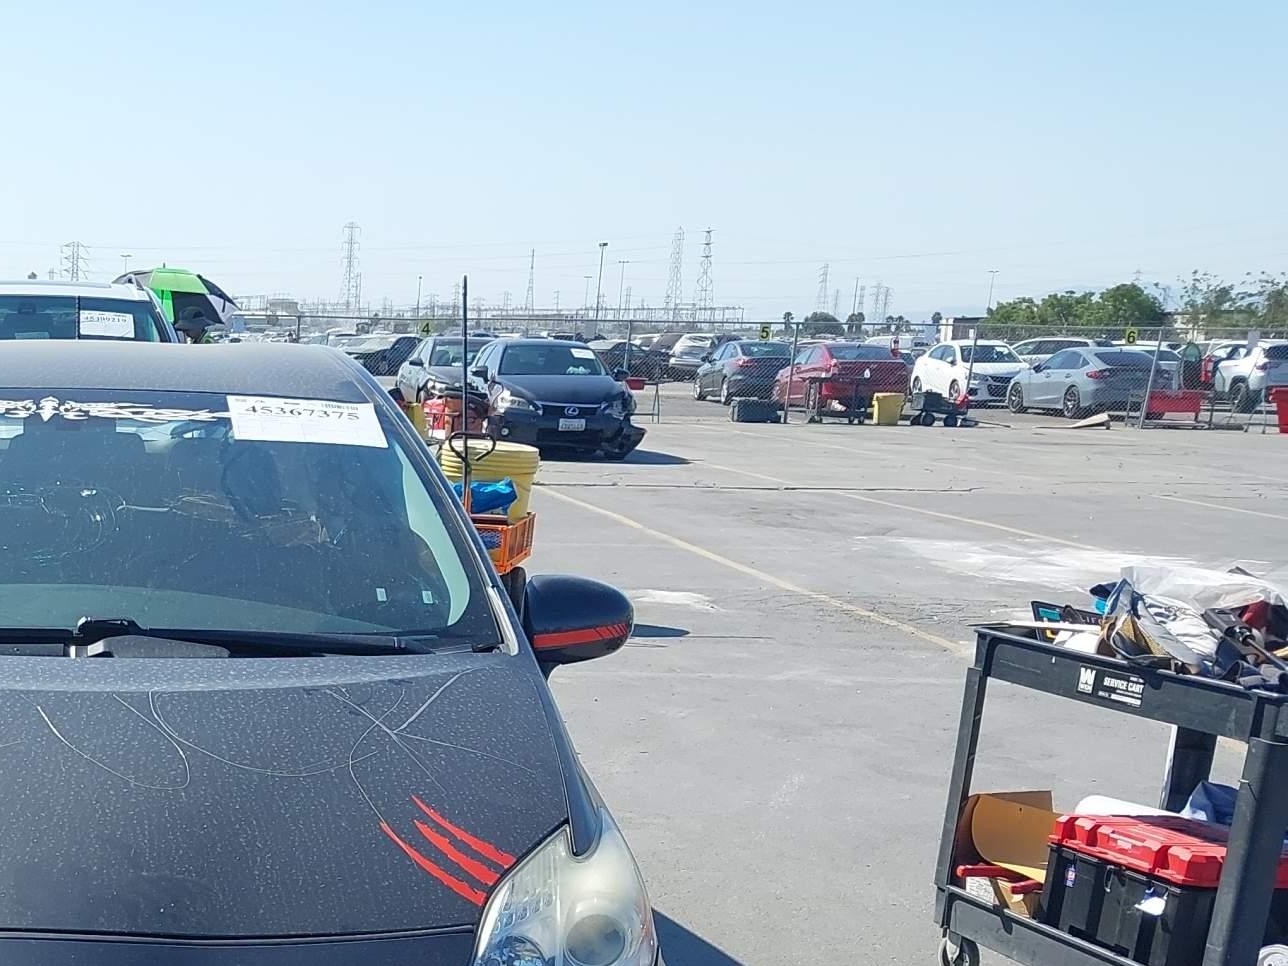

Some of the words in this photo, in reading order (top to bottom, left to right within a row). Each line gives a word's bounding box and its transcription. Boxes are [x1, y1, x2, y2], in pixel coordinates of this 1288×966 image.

[421, 322, 431, 335] 4
[761, 326, 770, 339] 5
[1128, 331, 1136, 344] 6
[245, 405, 360, 420] 45367375
[1103, 676, 1128, 690] SERVICE
[1127, 682, 1144, 693] CART
